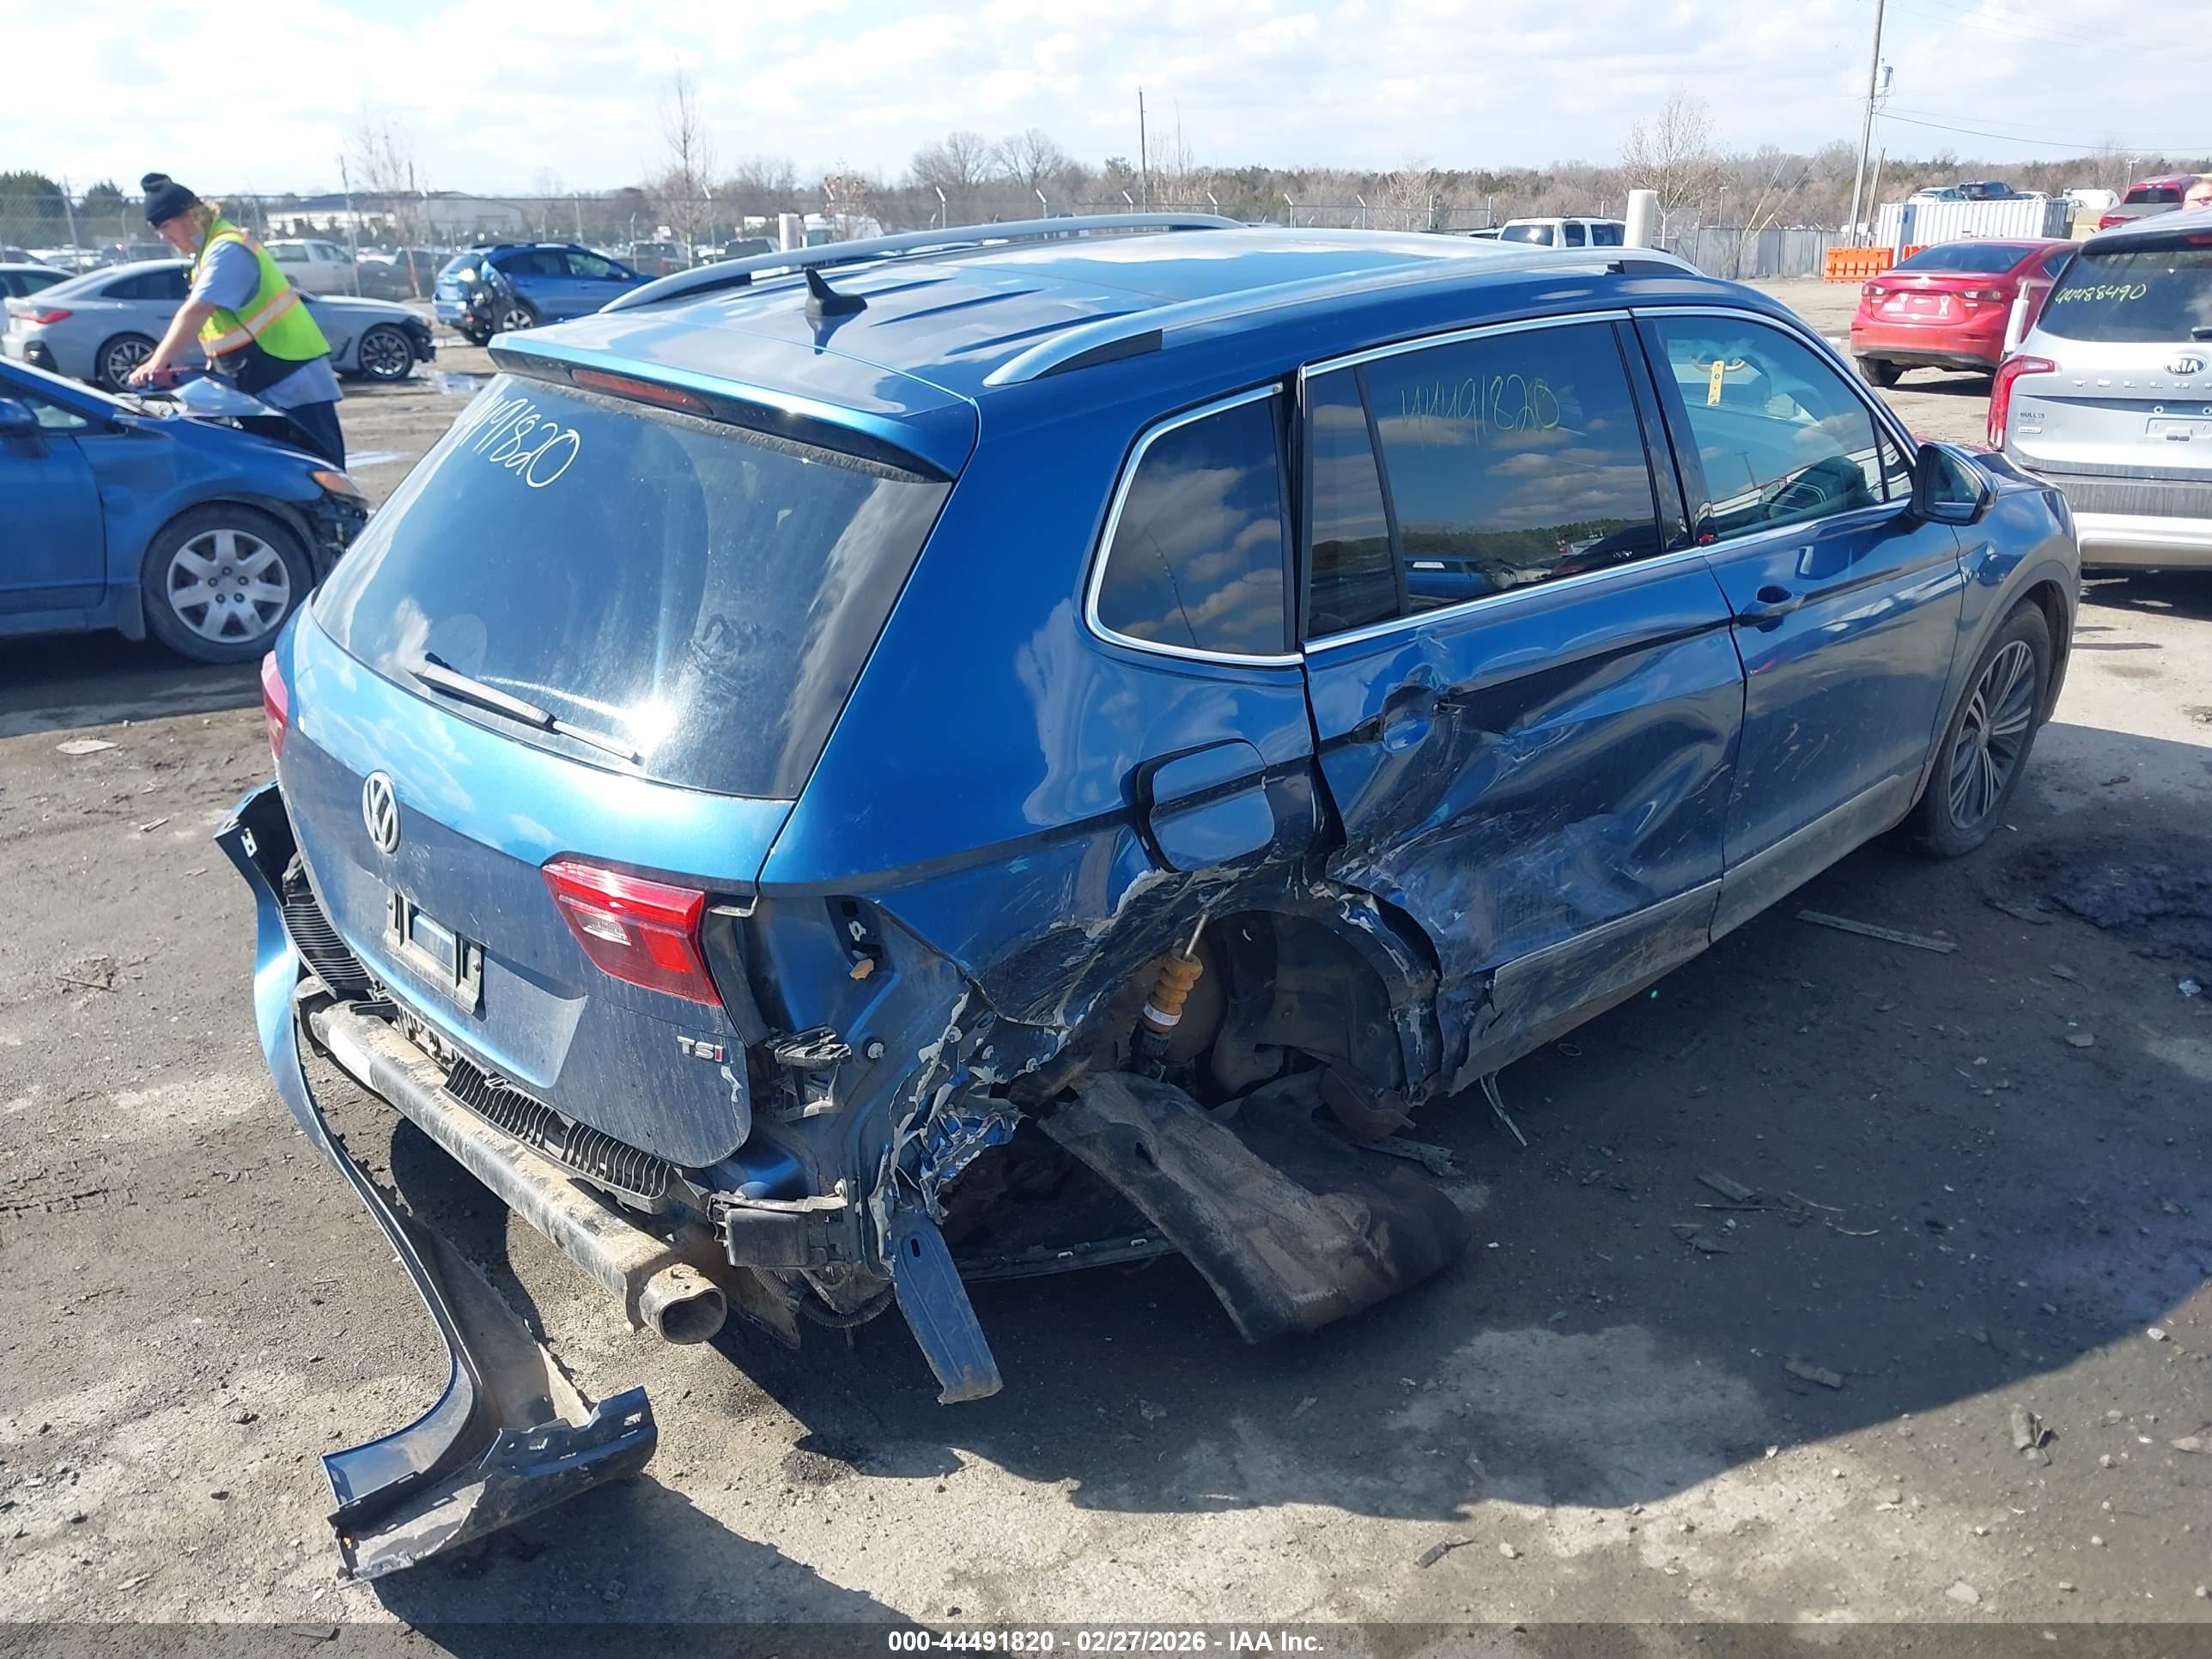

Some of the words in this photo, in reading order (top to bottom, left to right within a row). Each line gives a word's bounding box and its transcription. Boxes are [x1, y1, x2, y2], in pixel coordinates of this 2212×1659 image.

[2055, 283, 2147, 305] 44488490
[2165, 359, 2199, 374] KIA
[1401, 373, 1560, 447] 44491820
[364, 771, 400, 854] VW
